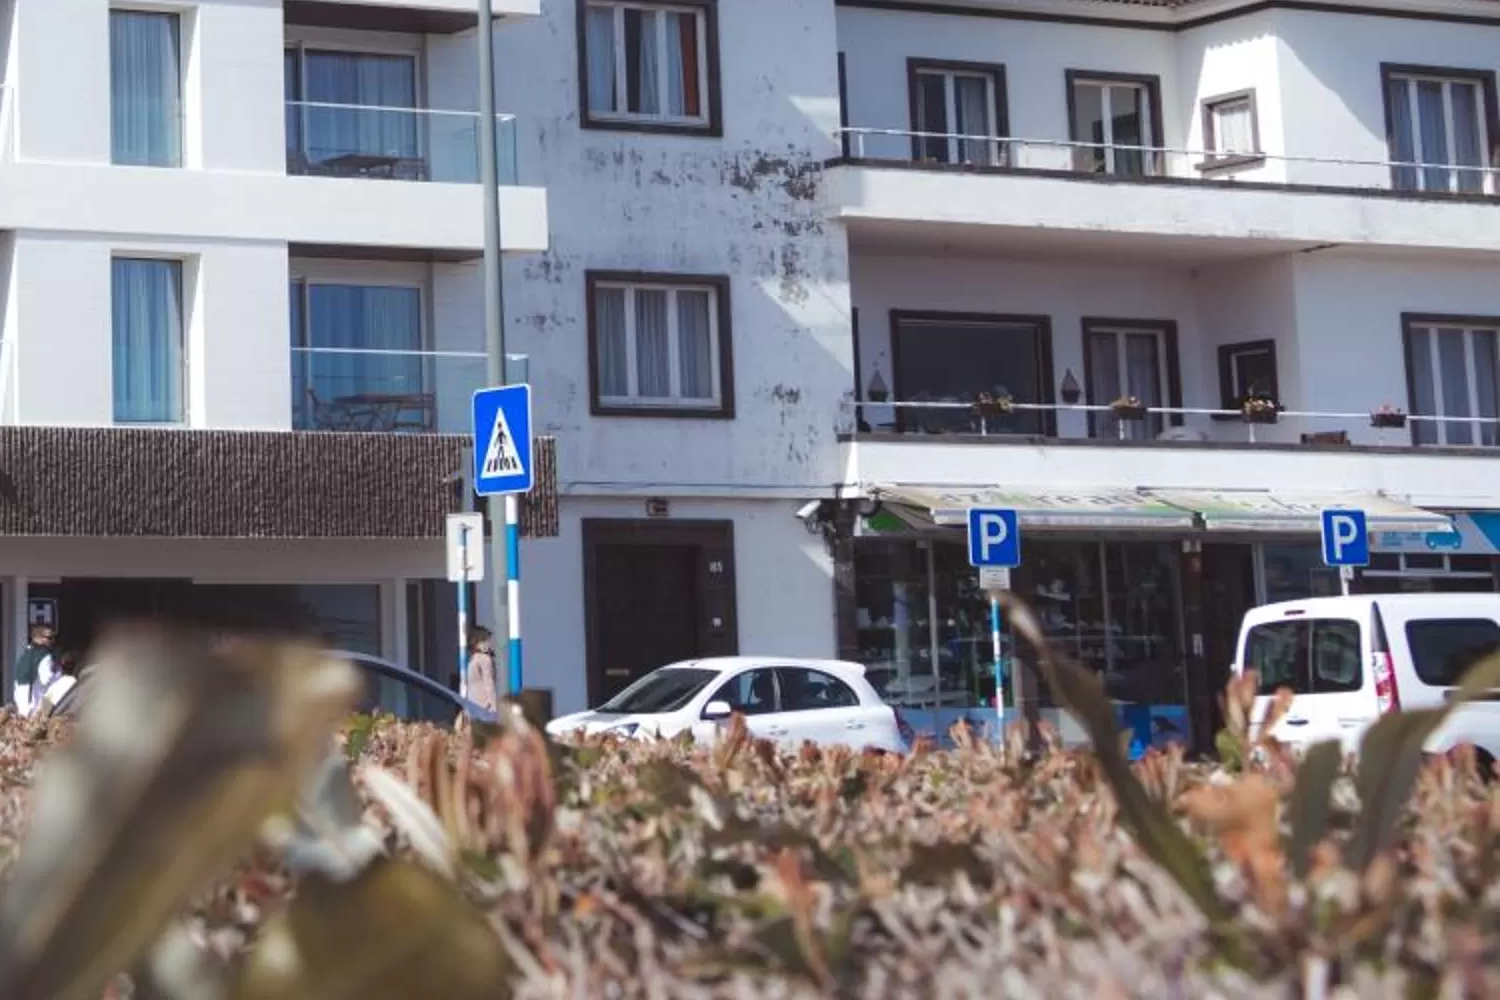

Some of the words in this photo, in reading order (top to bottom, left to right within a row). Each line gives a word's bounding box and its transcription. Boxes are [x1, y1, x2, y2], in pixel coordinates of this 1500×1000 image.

[979, 513, 1007, 560] P
[1331, 515, 1357, 560] P
[29, 603, 52, 625] H
